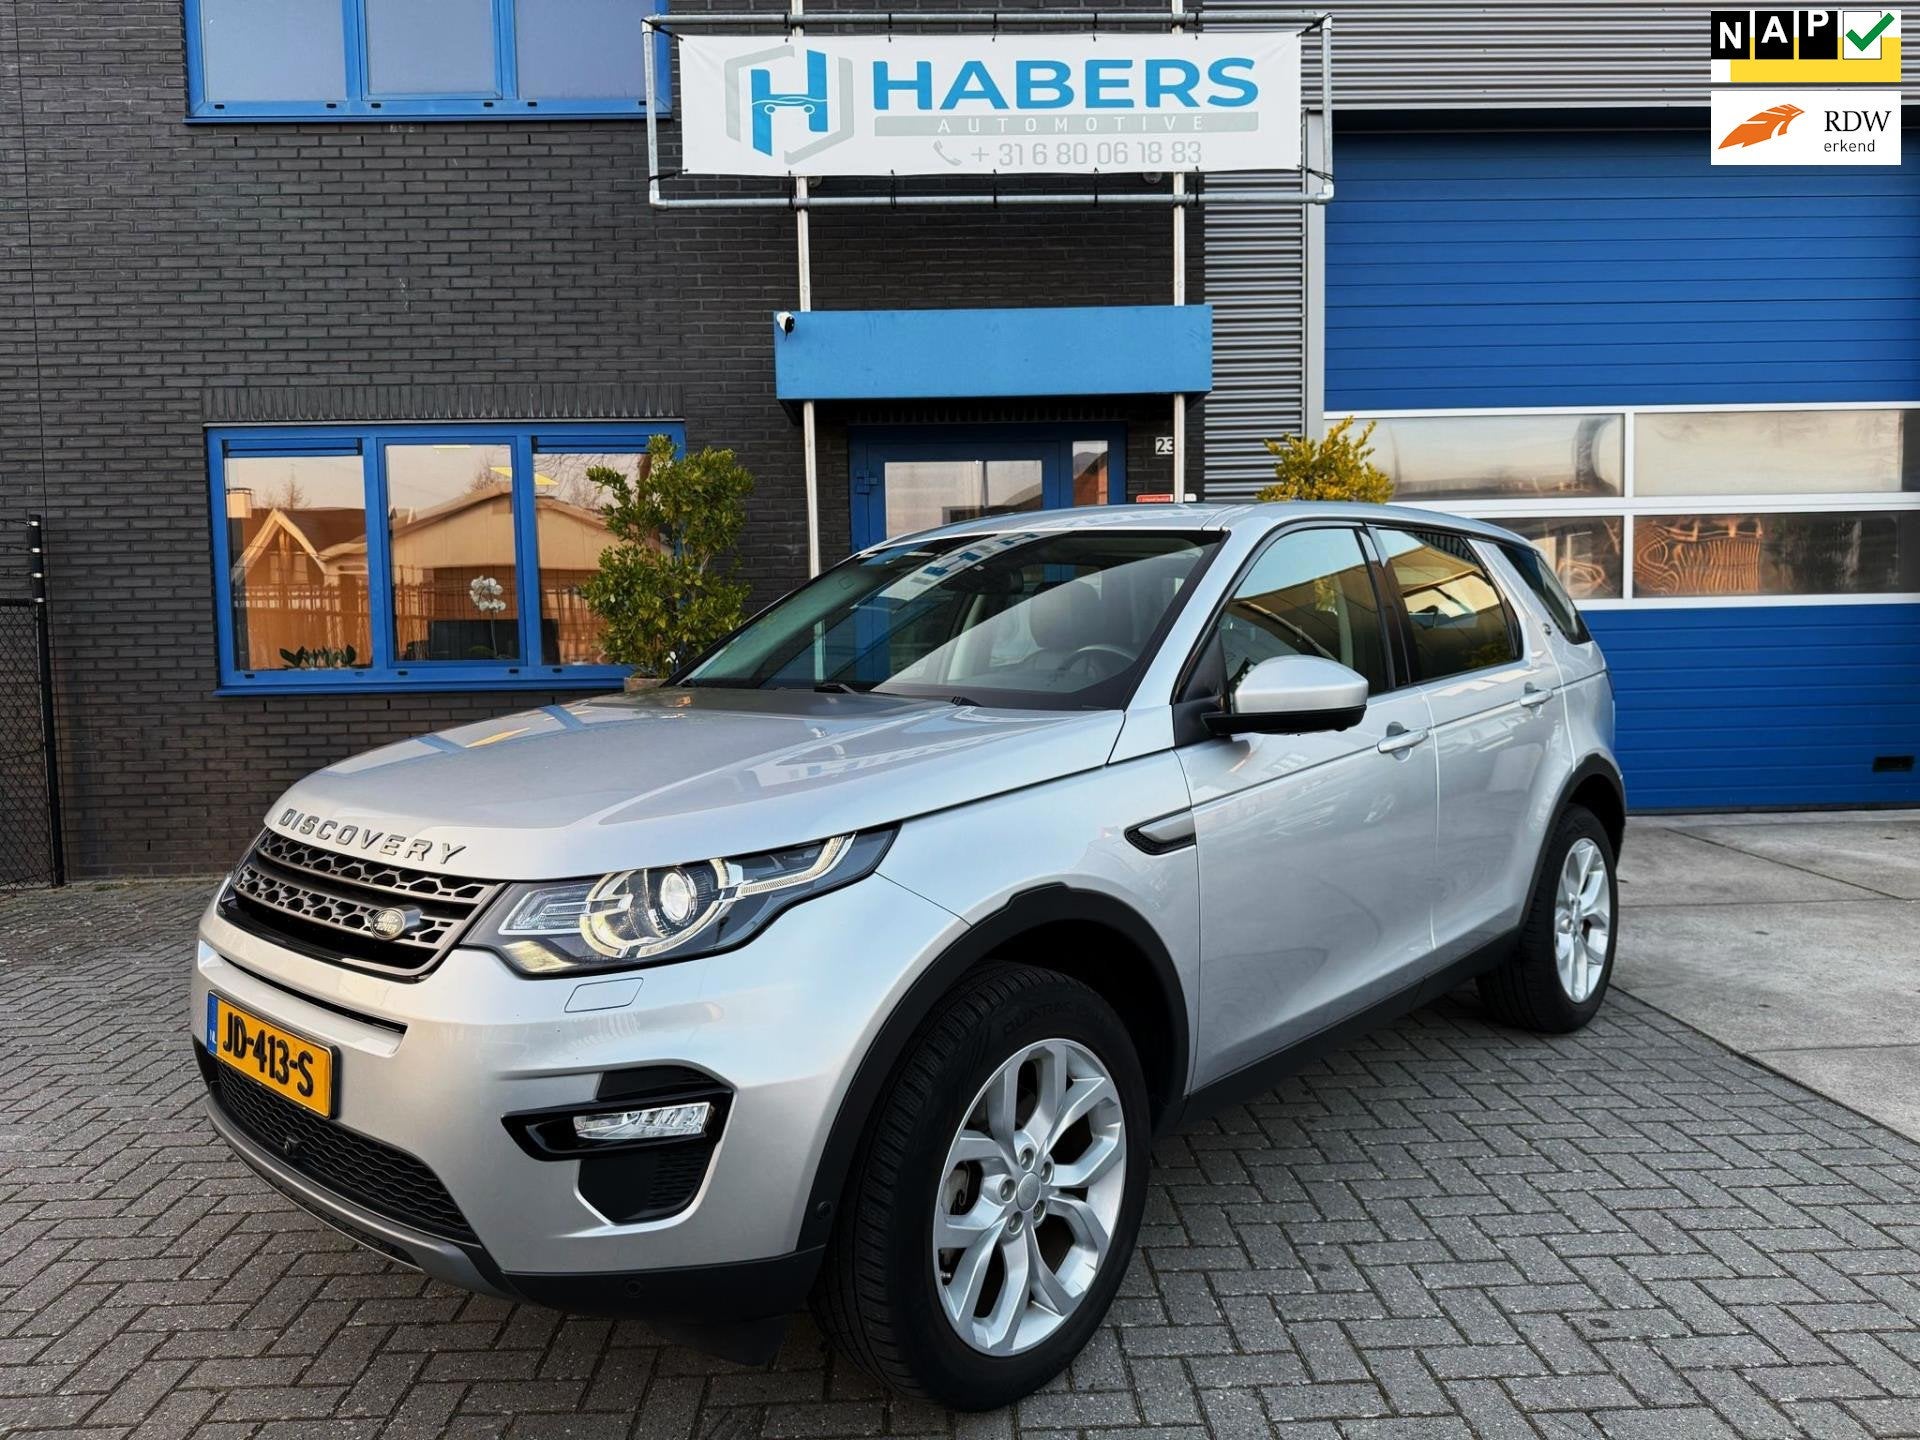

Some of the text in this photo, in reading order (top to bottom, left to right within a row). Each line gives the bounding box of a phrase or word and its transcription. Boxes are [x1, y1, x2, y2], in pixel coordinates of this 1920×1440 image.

[873, 57, 1259, 110] HABERS
[937, 116, 1206, 134] AUTOMOTIVE
[999, 142, 1024, 167] 31
[1032, 142, 1049, 166] 6
[1055, 141, 1089, 165] 80
[1096, 141, 1130, 165] 06
[1137, 141, 1163, 164] 18
[1170, 140, 1202, 164] 83
[278, 808, 467, 865] DISCOVERY
[223, 1012, 314, 1098] JD-413-S
